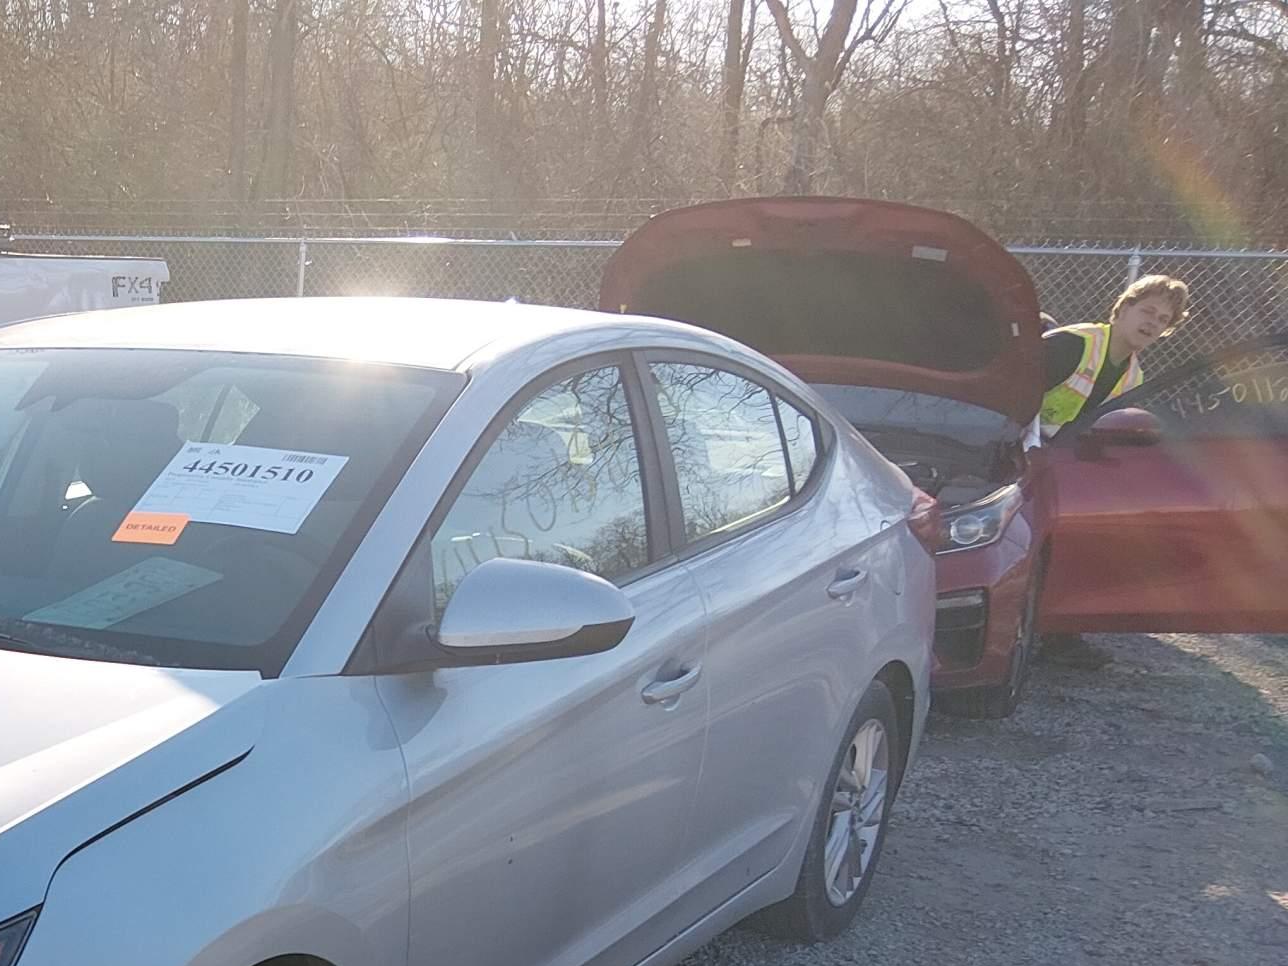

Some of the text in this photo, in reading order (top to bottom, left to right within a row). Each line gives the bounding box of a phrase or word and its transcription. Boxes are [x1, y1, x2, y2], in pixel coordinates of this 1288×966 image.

[111, 275, 153, 298] FX4
[182, 458, 315, 484] 44501510
[125, 523, 177, 533] DETAILED
